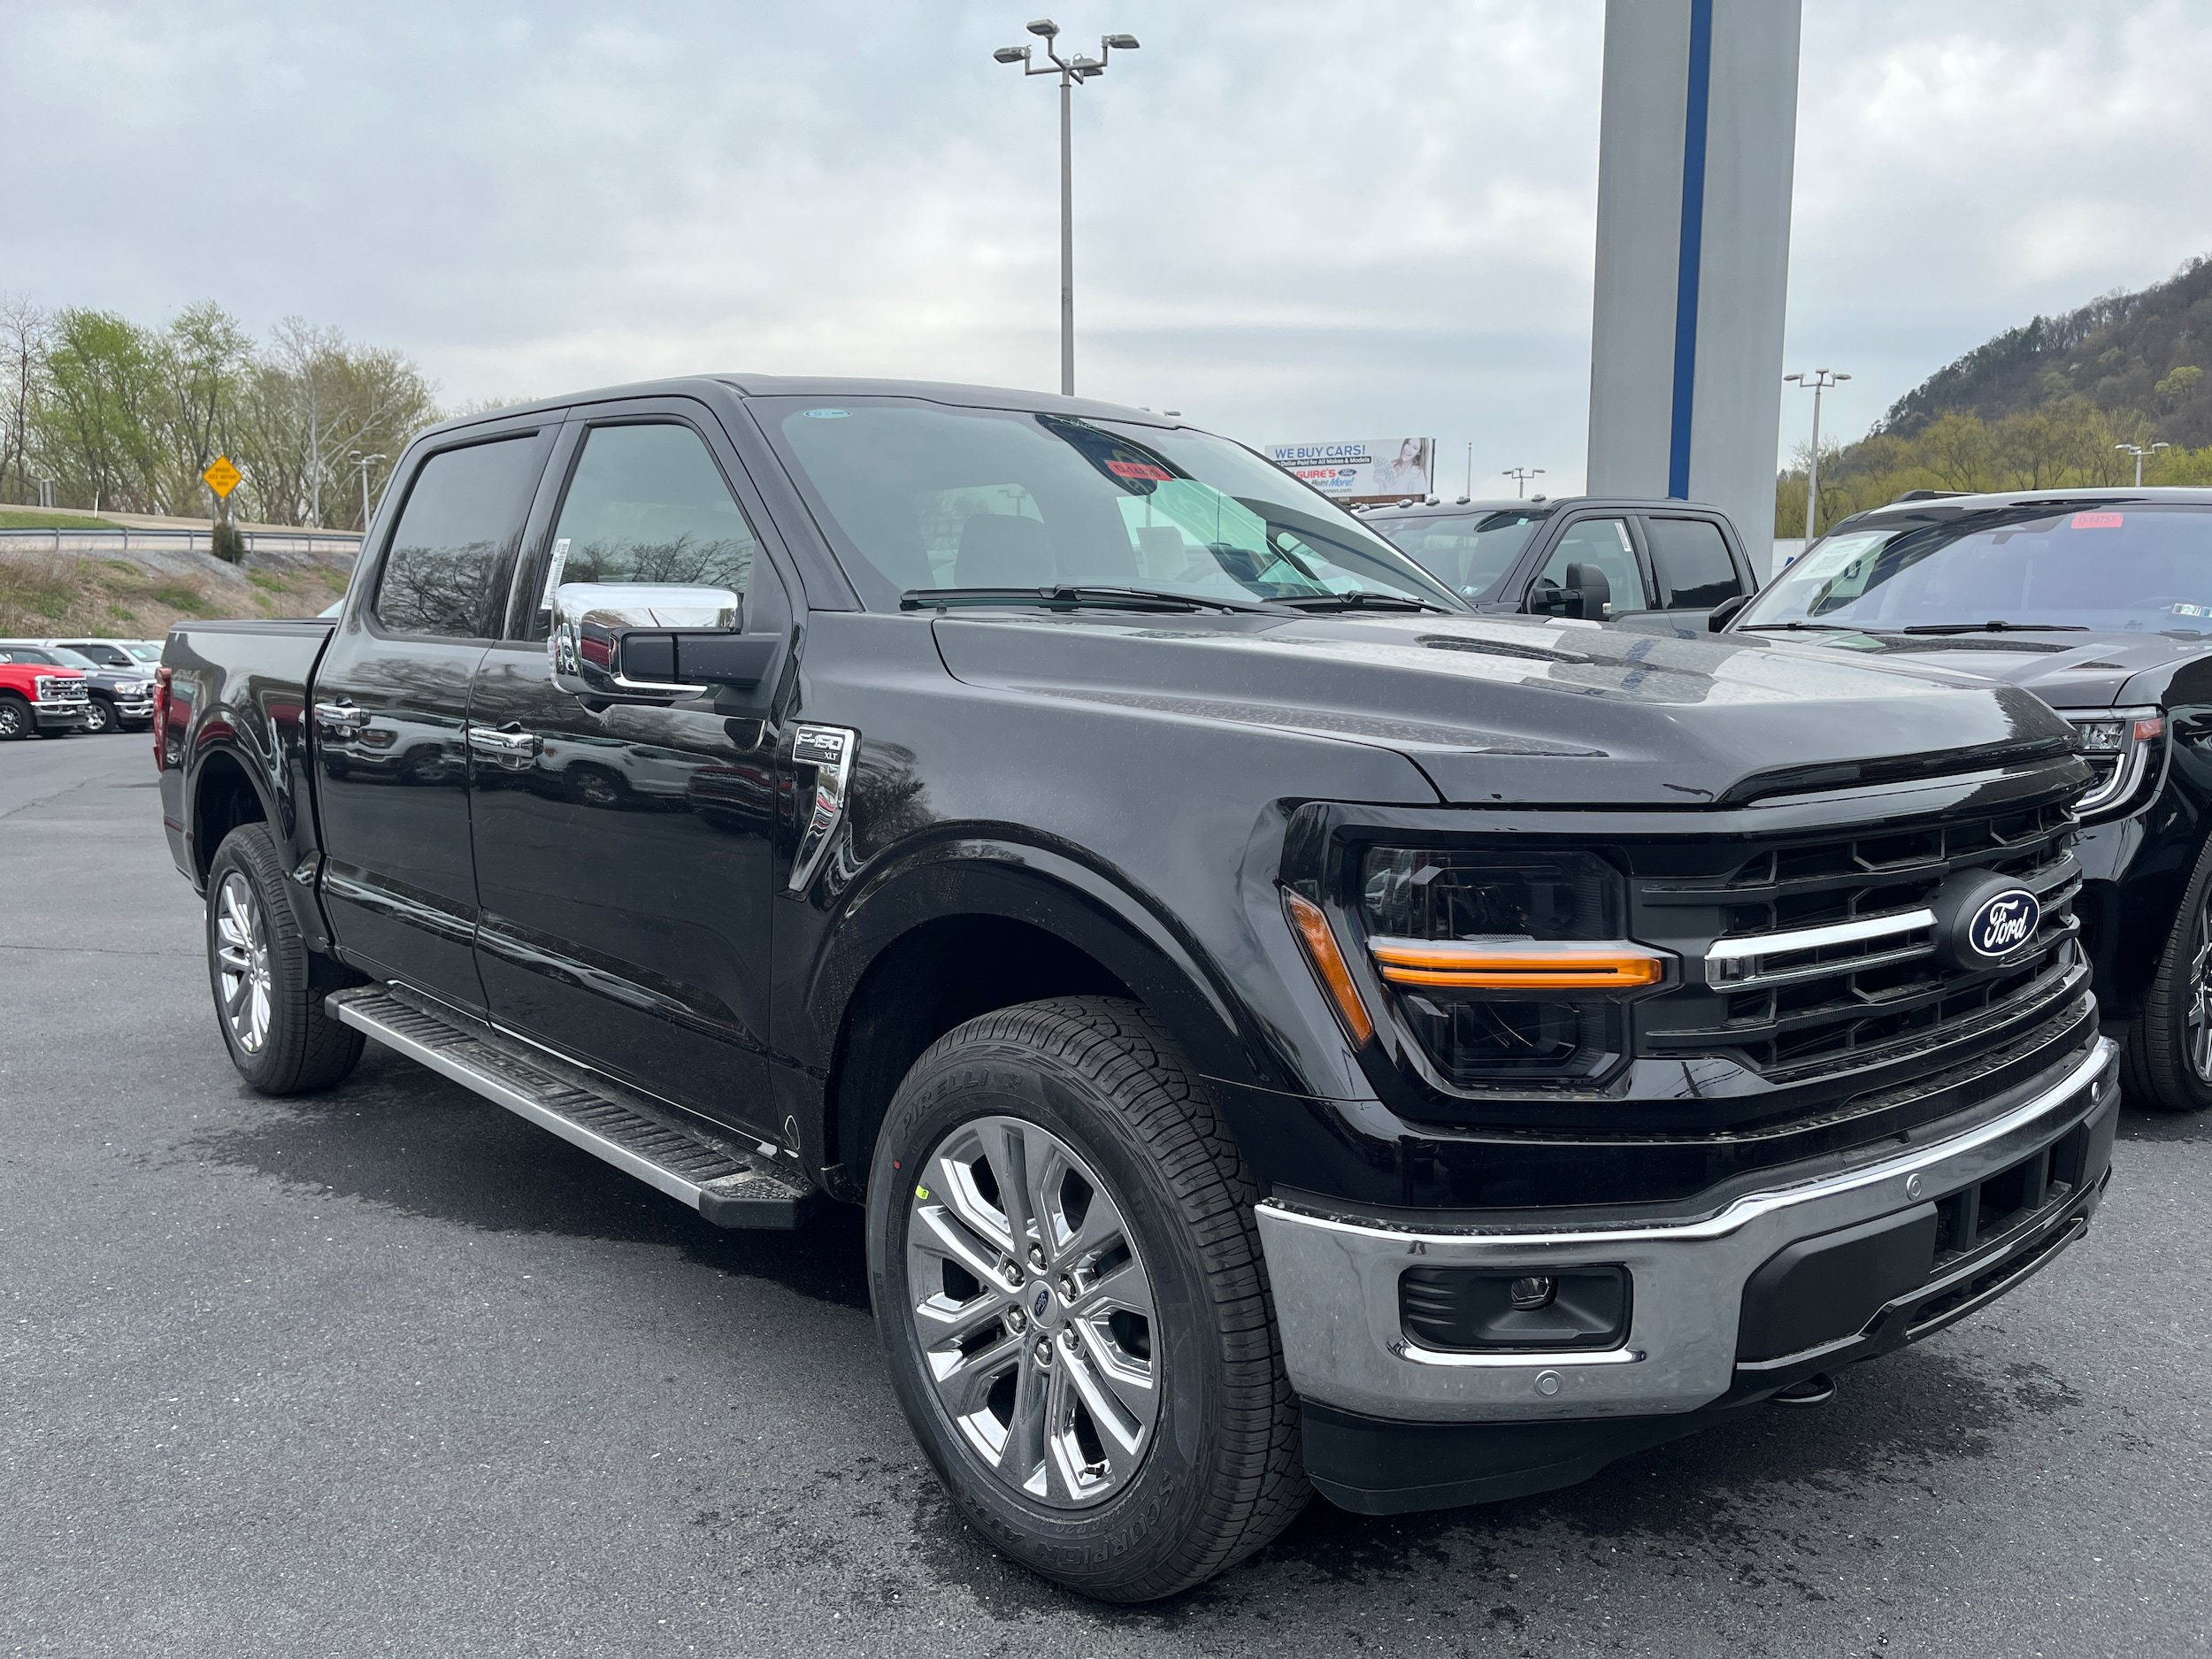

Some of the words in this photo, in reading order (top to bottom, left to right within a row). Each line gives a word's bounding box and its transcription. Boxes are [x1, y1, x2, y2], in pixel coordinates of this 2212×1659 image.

[1275, 448, 1294, 458] WE
[1297, 447, 1324, 458] BUY
[1326, 445, 1366, 457] CARS!
[1294, 468, 1336, 479] GUIRE'S
[1329, 477, 1355, 487] More!
[797, 733, 844, 751] F-150
[824, 751, 838, 760] XLT
[1984, 900, 2029, 948] Ford
[901, 1067, 991, 1141] PIRELLI
[1036, 1471, 1176, 1566] SCORPION
